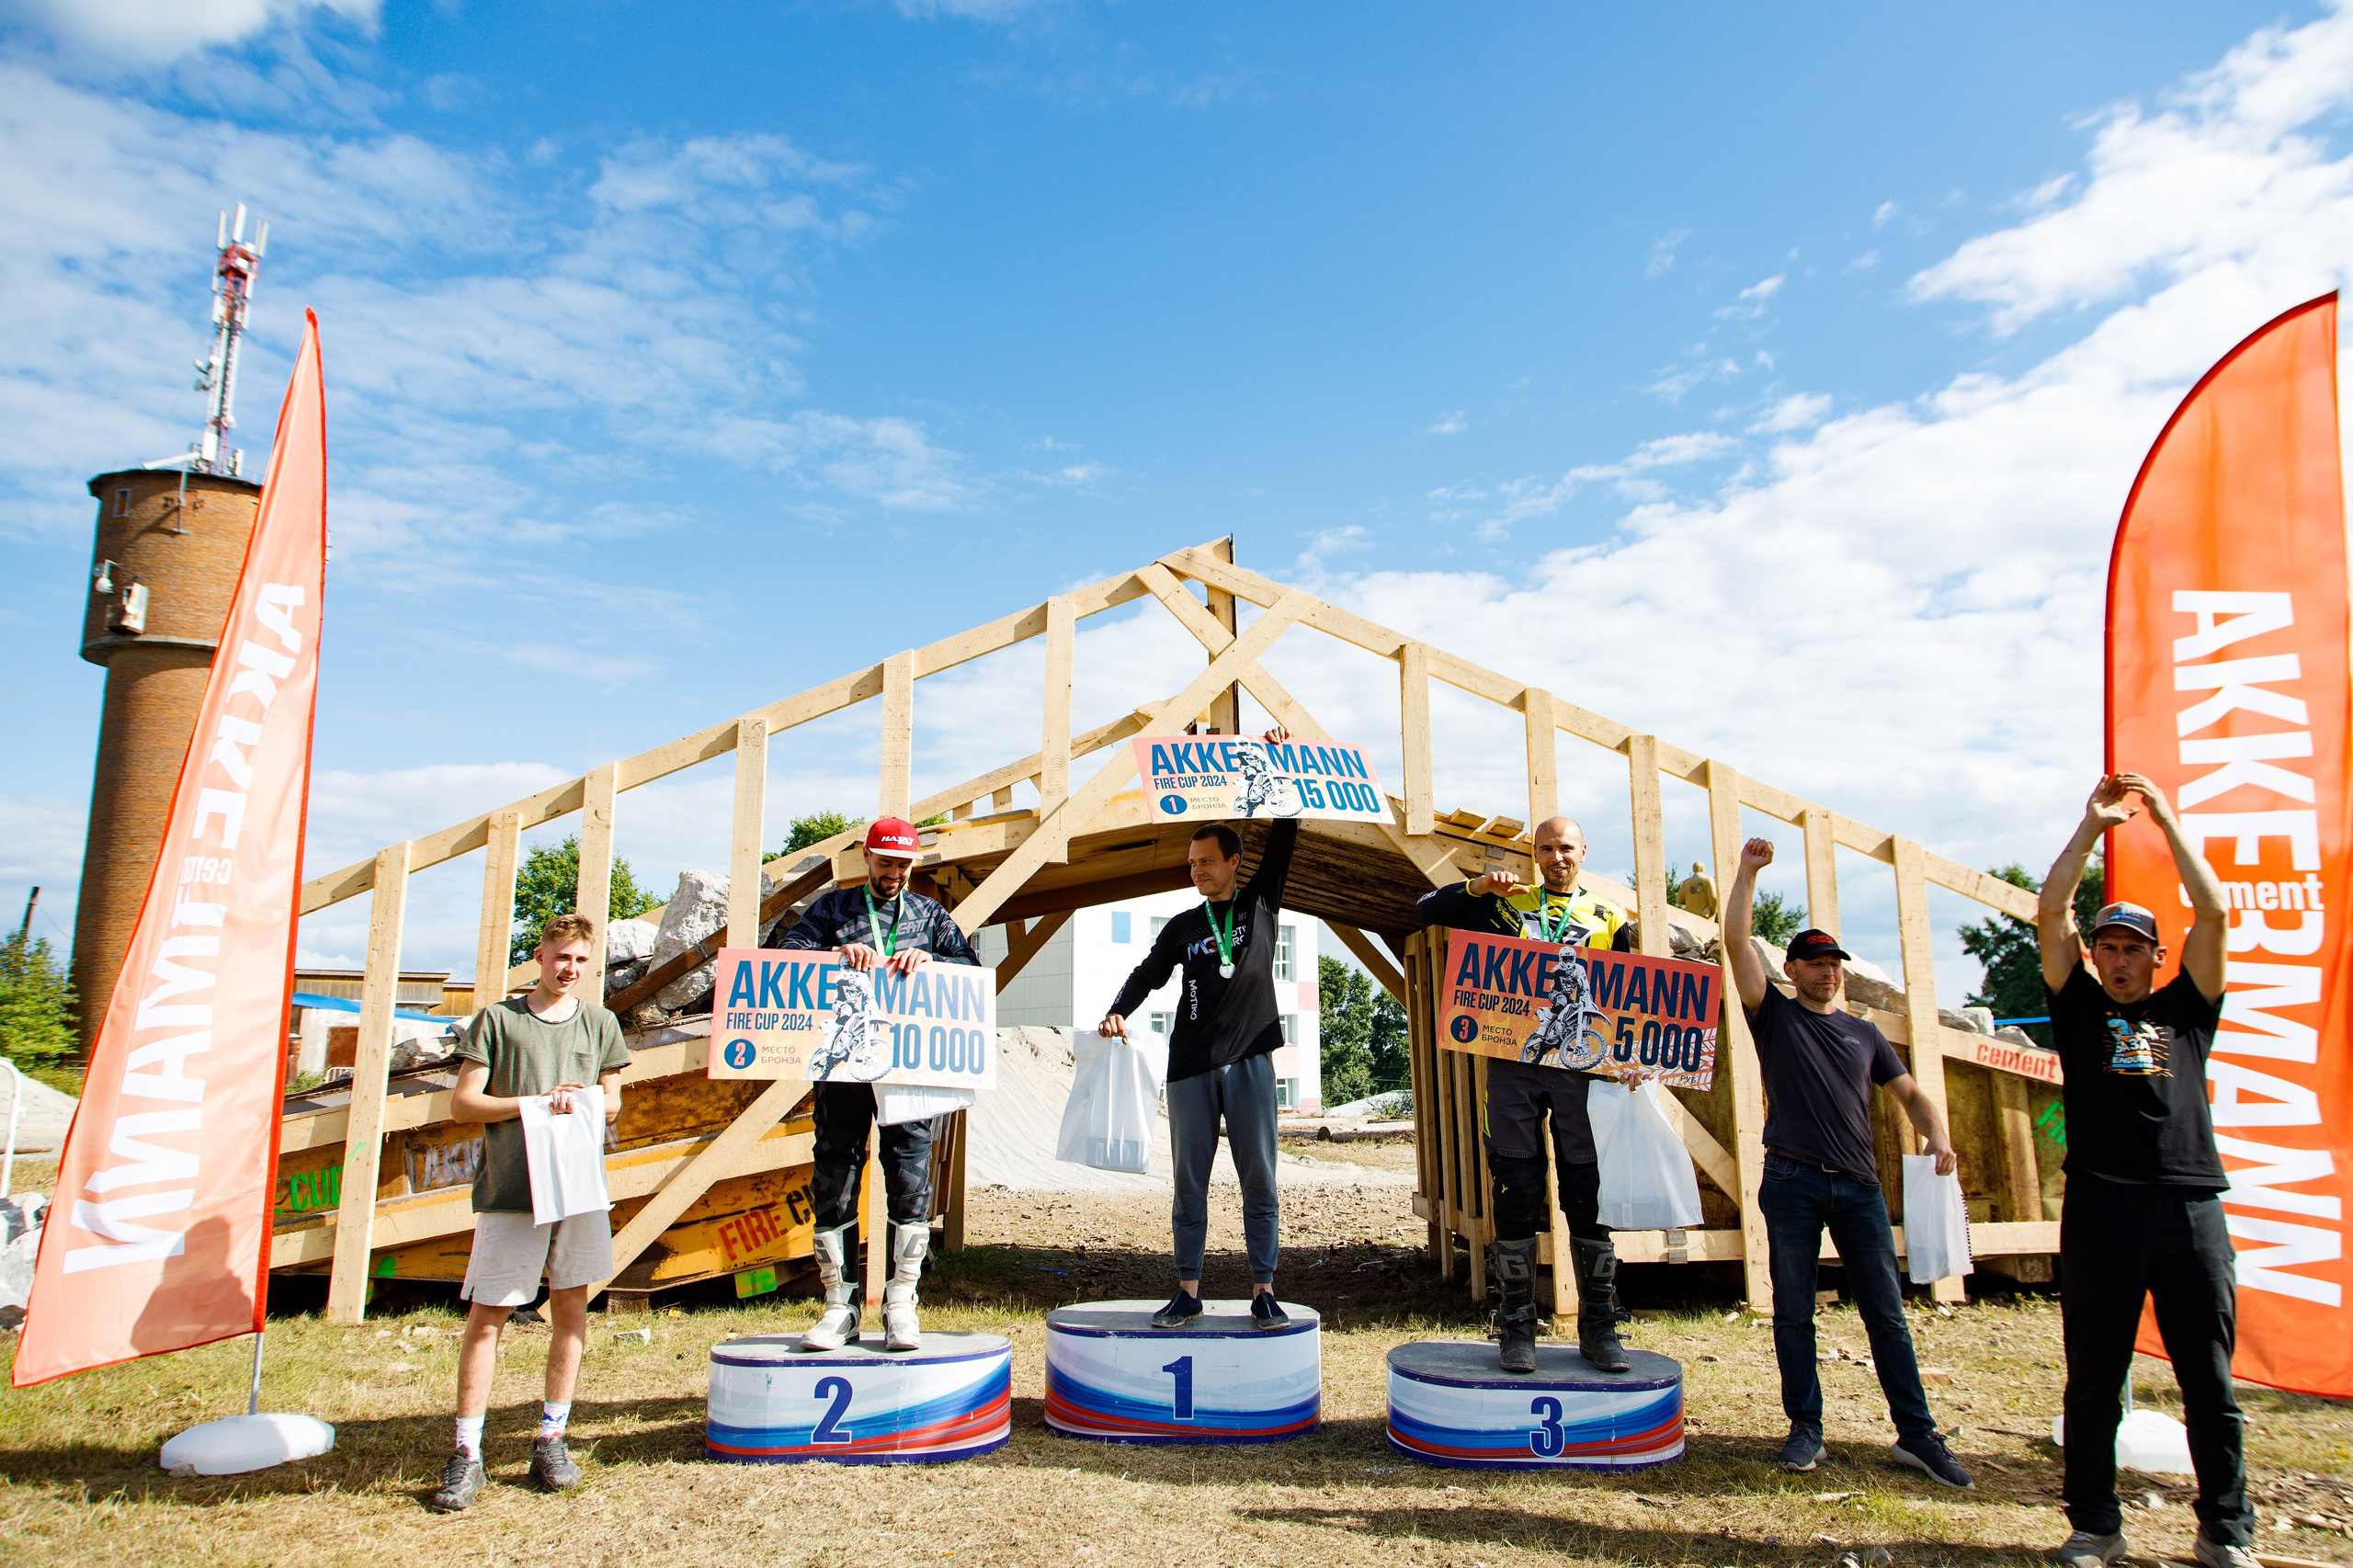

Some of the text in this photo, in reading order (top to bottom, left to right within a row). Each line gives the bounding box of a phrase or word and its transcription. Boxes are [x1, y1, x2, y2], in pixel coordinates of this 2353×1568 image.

[1154, 775, 1227, 790] FIRE CUP 2024
[1291, 778, 1381, 813] 15 000
[2178, 873, 2325, 910] ment
[897, 917, 928, 935] EATT
[728, 960, 985, 1023] AKKEMANN
[1188, 979, 1198, 1020] MOTIKO
[1456, 942, 1711, 1022] AKKEMANN
[1453, 989, 1530, 1017] FIRE CUP 2024
[726, 1012, 813, 1031] FIRE CUP 2024
[1459, 1018, 1470, 1040] 3
[1483, 1024, 1513, 1036] МЕСТО
[733, 1042, 746, 1066] 2
[761, 1046, 796, 1054] МЕСТО
[889, 1023, 984, 1074] 10 000
[1481, 1034, 1518, 1046] БРОНЗА
[1613, 1016, 1702, 1074] 5 000
[761, 1056, 801, 1064] БРОНЗА
[1977, 1043, 2058, 1079] cement
[718, 1208, 789, 1261] FIRE
[1163, 1356, 1193, 1420] 1
[812, 1376, 853, 1444] 2
[1530, 1396, 1564, 1457] 3
